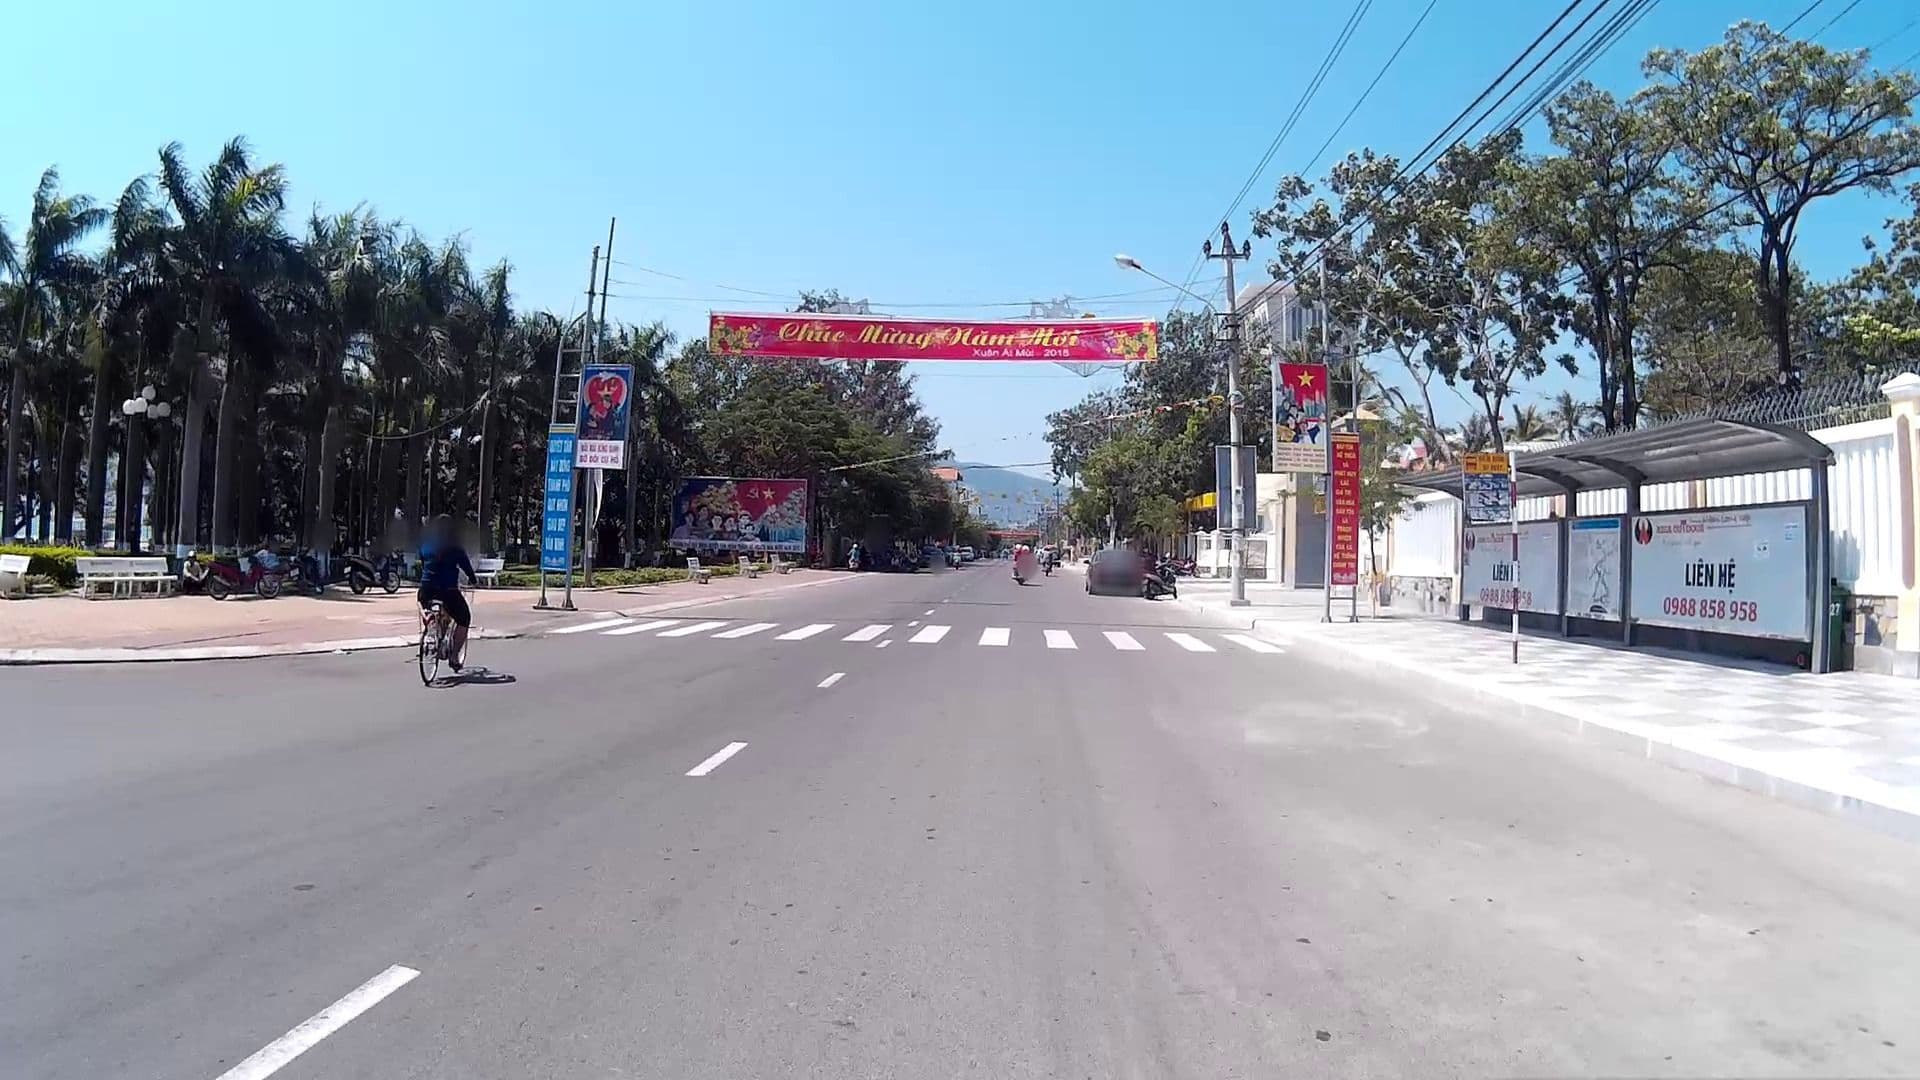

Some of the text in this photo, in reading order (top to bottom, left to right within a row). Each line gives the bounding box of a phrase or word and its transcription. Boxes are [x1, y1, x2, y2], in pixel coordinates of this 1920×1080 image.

[778, 321, 845, 343] Chúc
[855, 324, 933, 349] Mừng
[943, 326, 1015, 347] Năm
[972, 347, 1000, 358] Xuân
[1043, 348, 1070, 358] 2015
[1492, 560, 1509, 582] LIÊN
[1685, 557, 1736, 594] LIÊN HỆ
[1479, 587, 1499, 603] 0988
[1663, 597, 1758, 622] 0988 858 958
